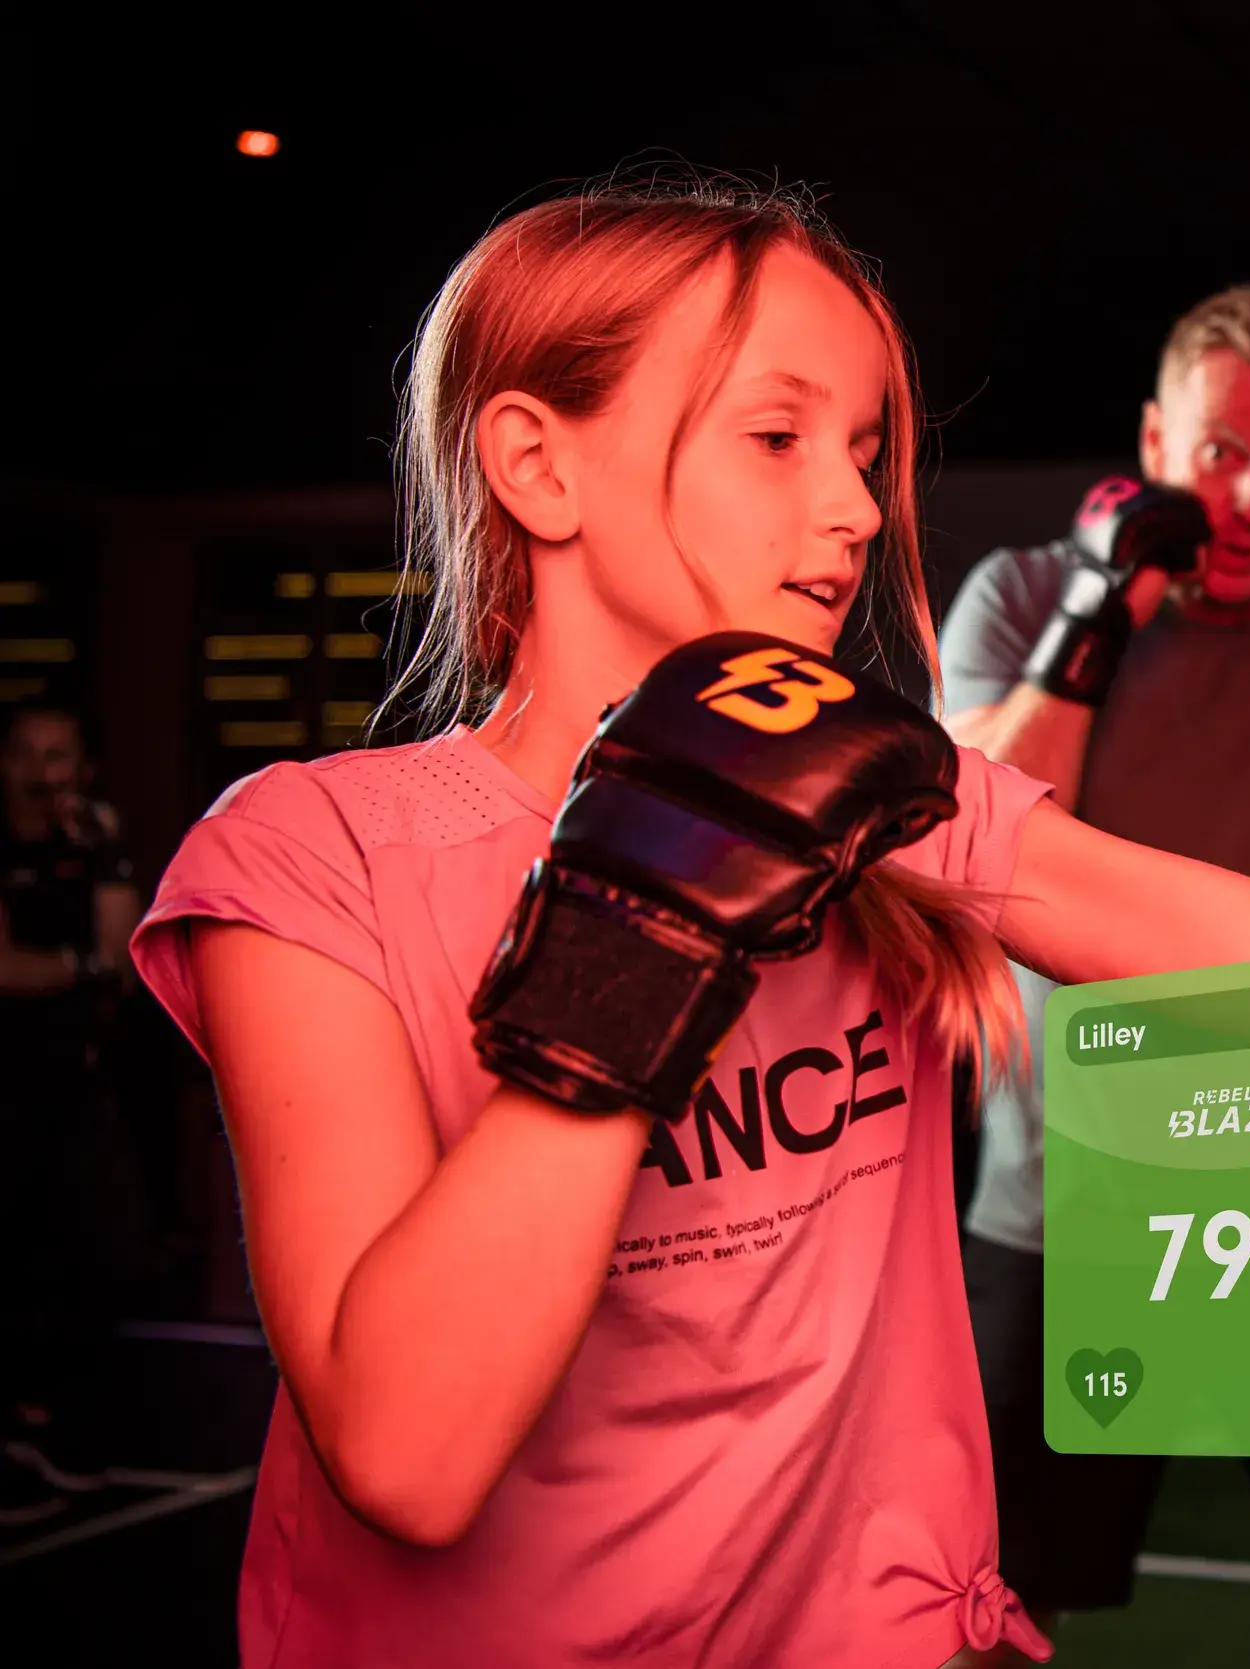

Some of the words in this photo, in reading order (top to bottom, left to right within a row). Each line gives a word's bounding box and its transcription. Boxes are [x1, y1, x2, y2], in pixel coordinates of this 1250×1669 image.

[659, 1233, 672, 1247] to
[726, 1215, 774, 1238] typically
[672, 1248, 709, 1267] spin,
[753, 1231, 784, 1252] twirl
